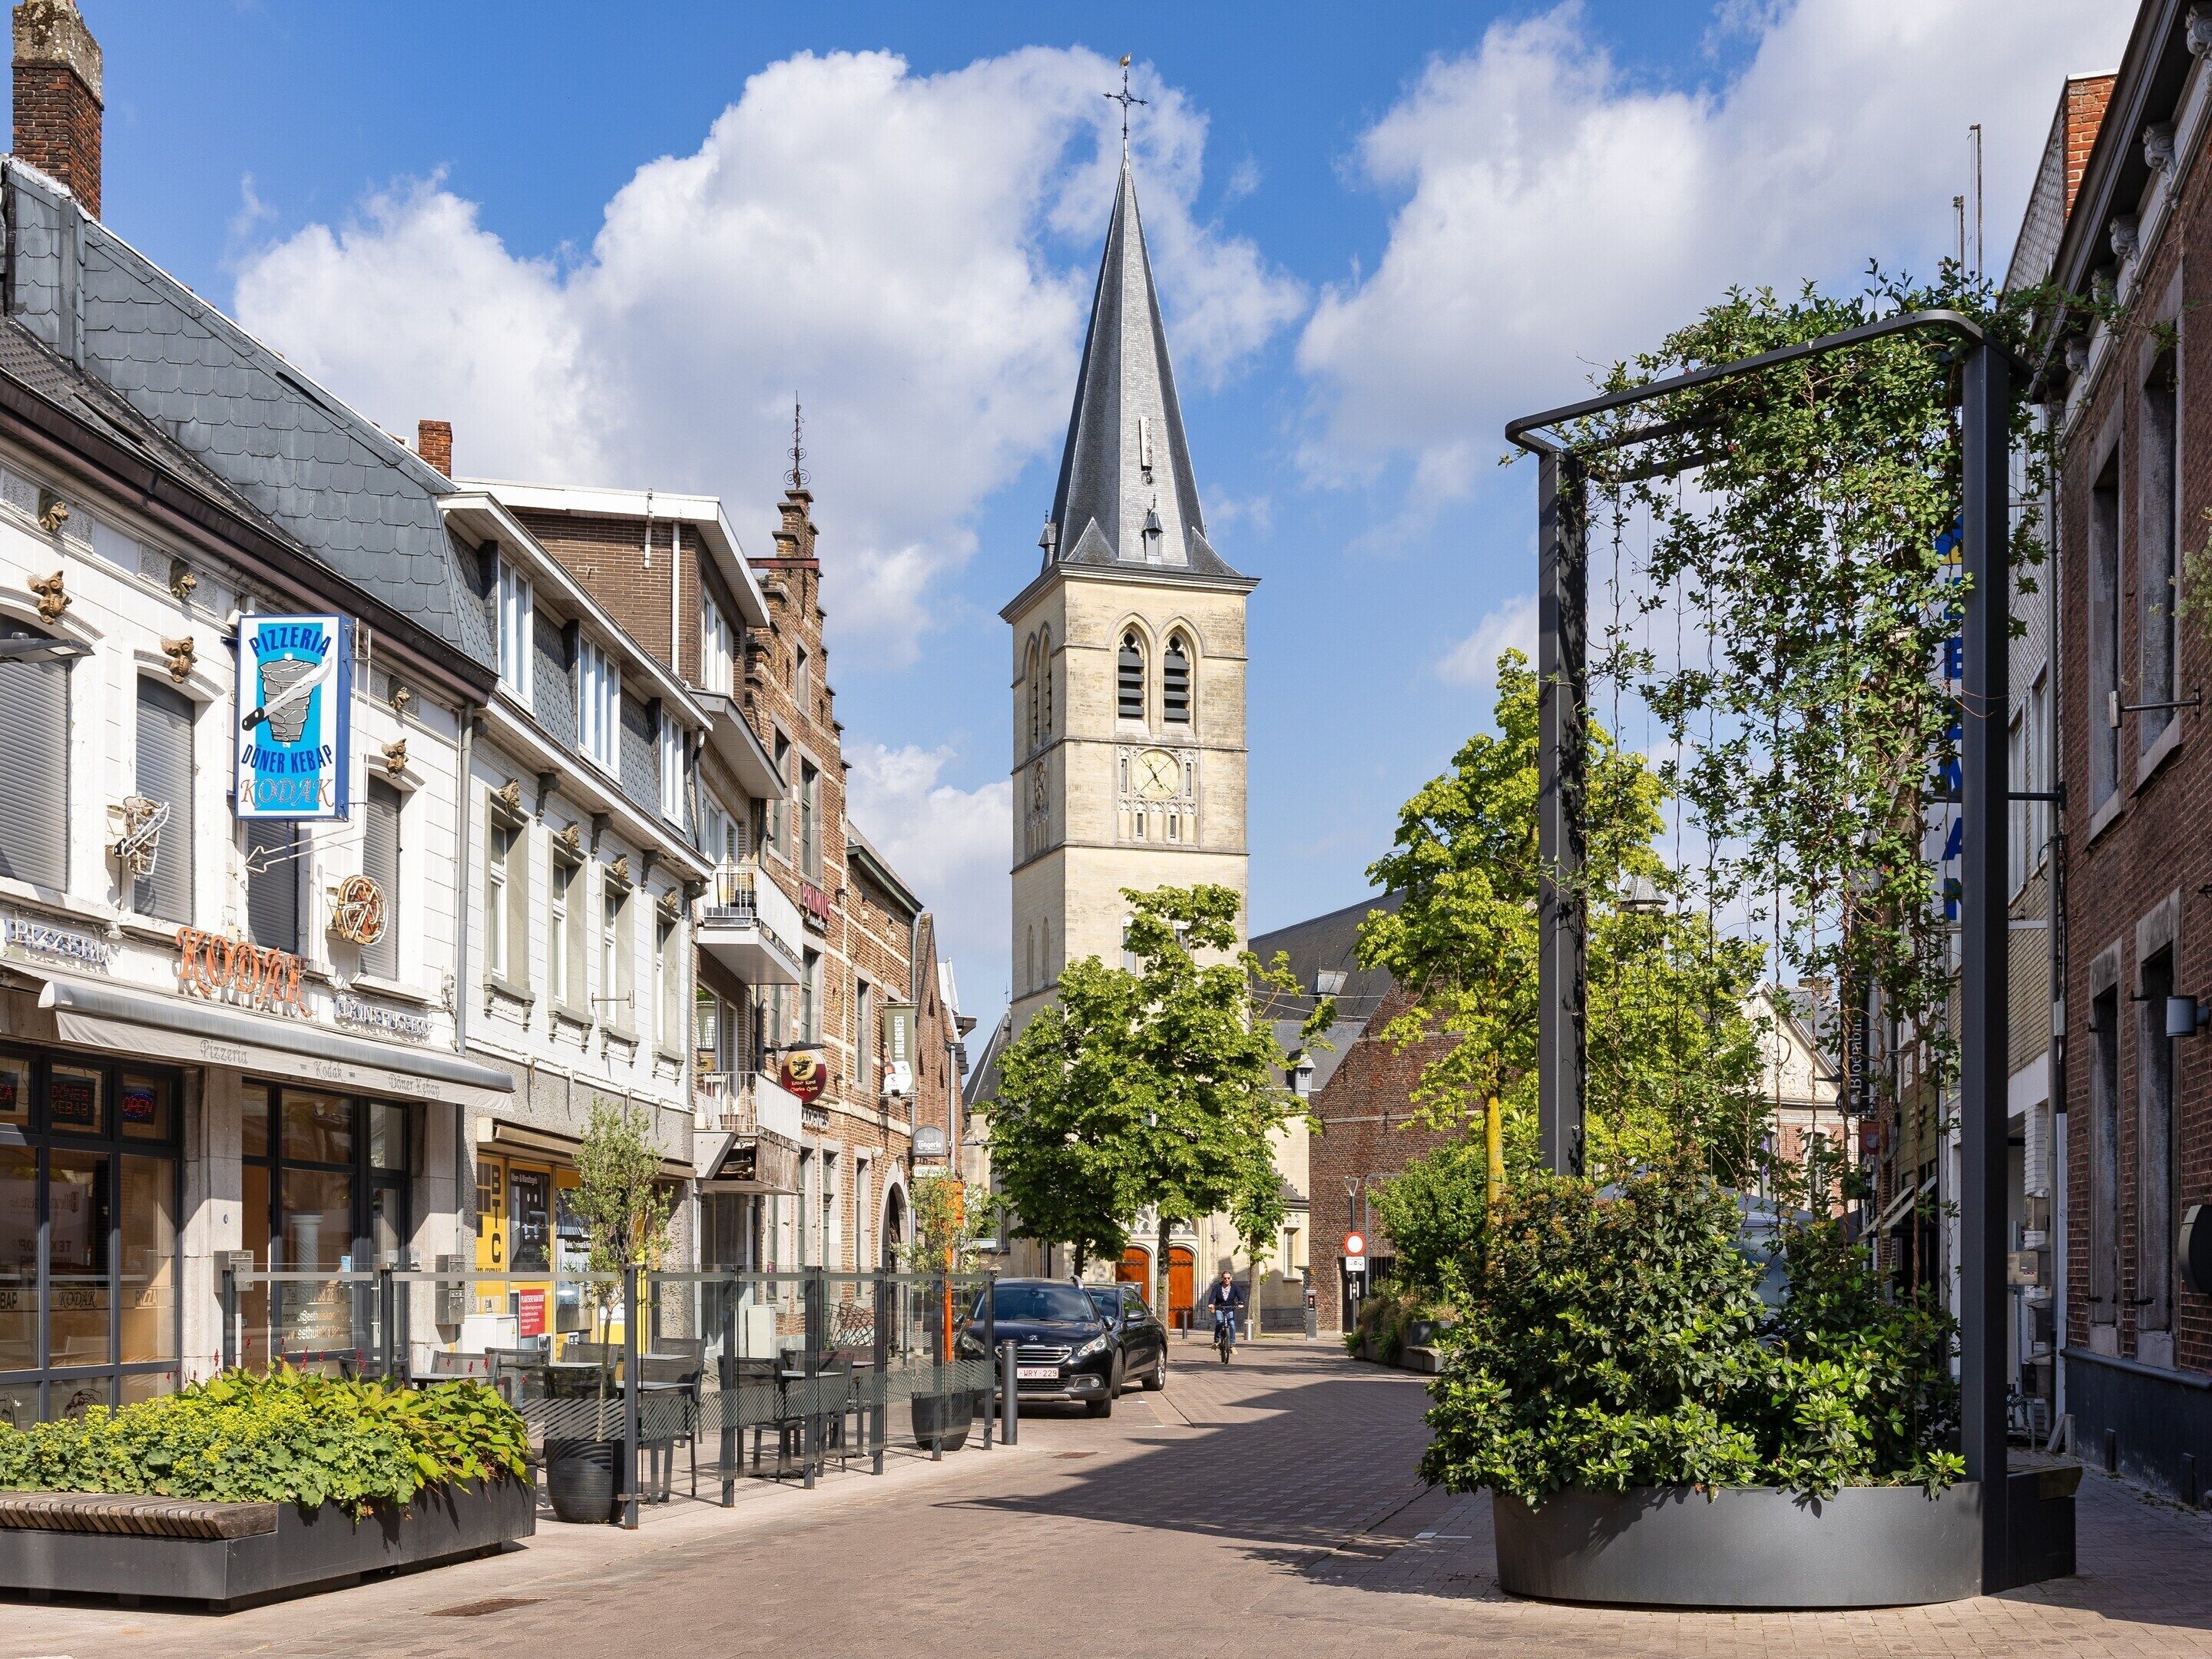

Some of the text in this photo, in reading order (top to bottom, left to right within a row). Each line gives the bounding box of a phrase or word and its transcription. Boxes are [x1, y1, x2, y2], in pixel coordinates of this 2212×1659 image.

[248, 626, 333, 658] PIZZERIA
[240, 743, 333, 774] DÖNER KEBAP
[240, 777, 334, 808] KODAK
[802, 882, 831, 921] PRIMUS
[175, 926, 316, 1018] KODAK
[894, 1015, 905, 1054] BOLOGNESI
[200, 1039, 440, 1099] Pizzeria Kodak Döner Kebap
[121, 1096, 154, 1113] OPEN
[916, 1140, 941, 1151] Tongerlo
[58, 1291, 97, 1309] KODAK
[135, 1290, 158, 1306] PIZZA
